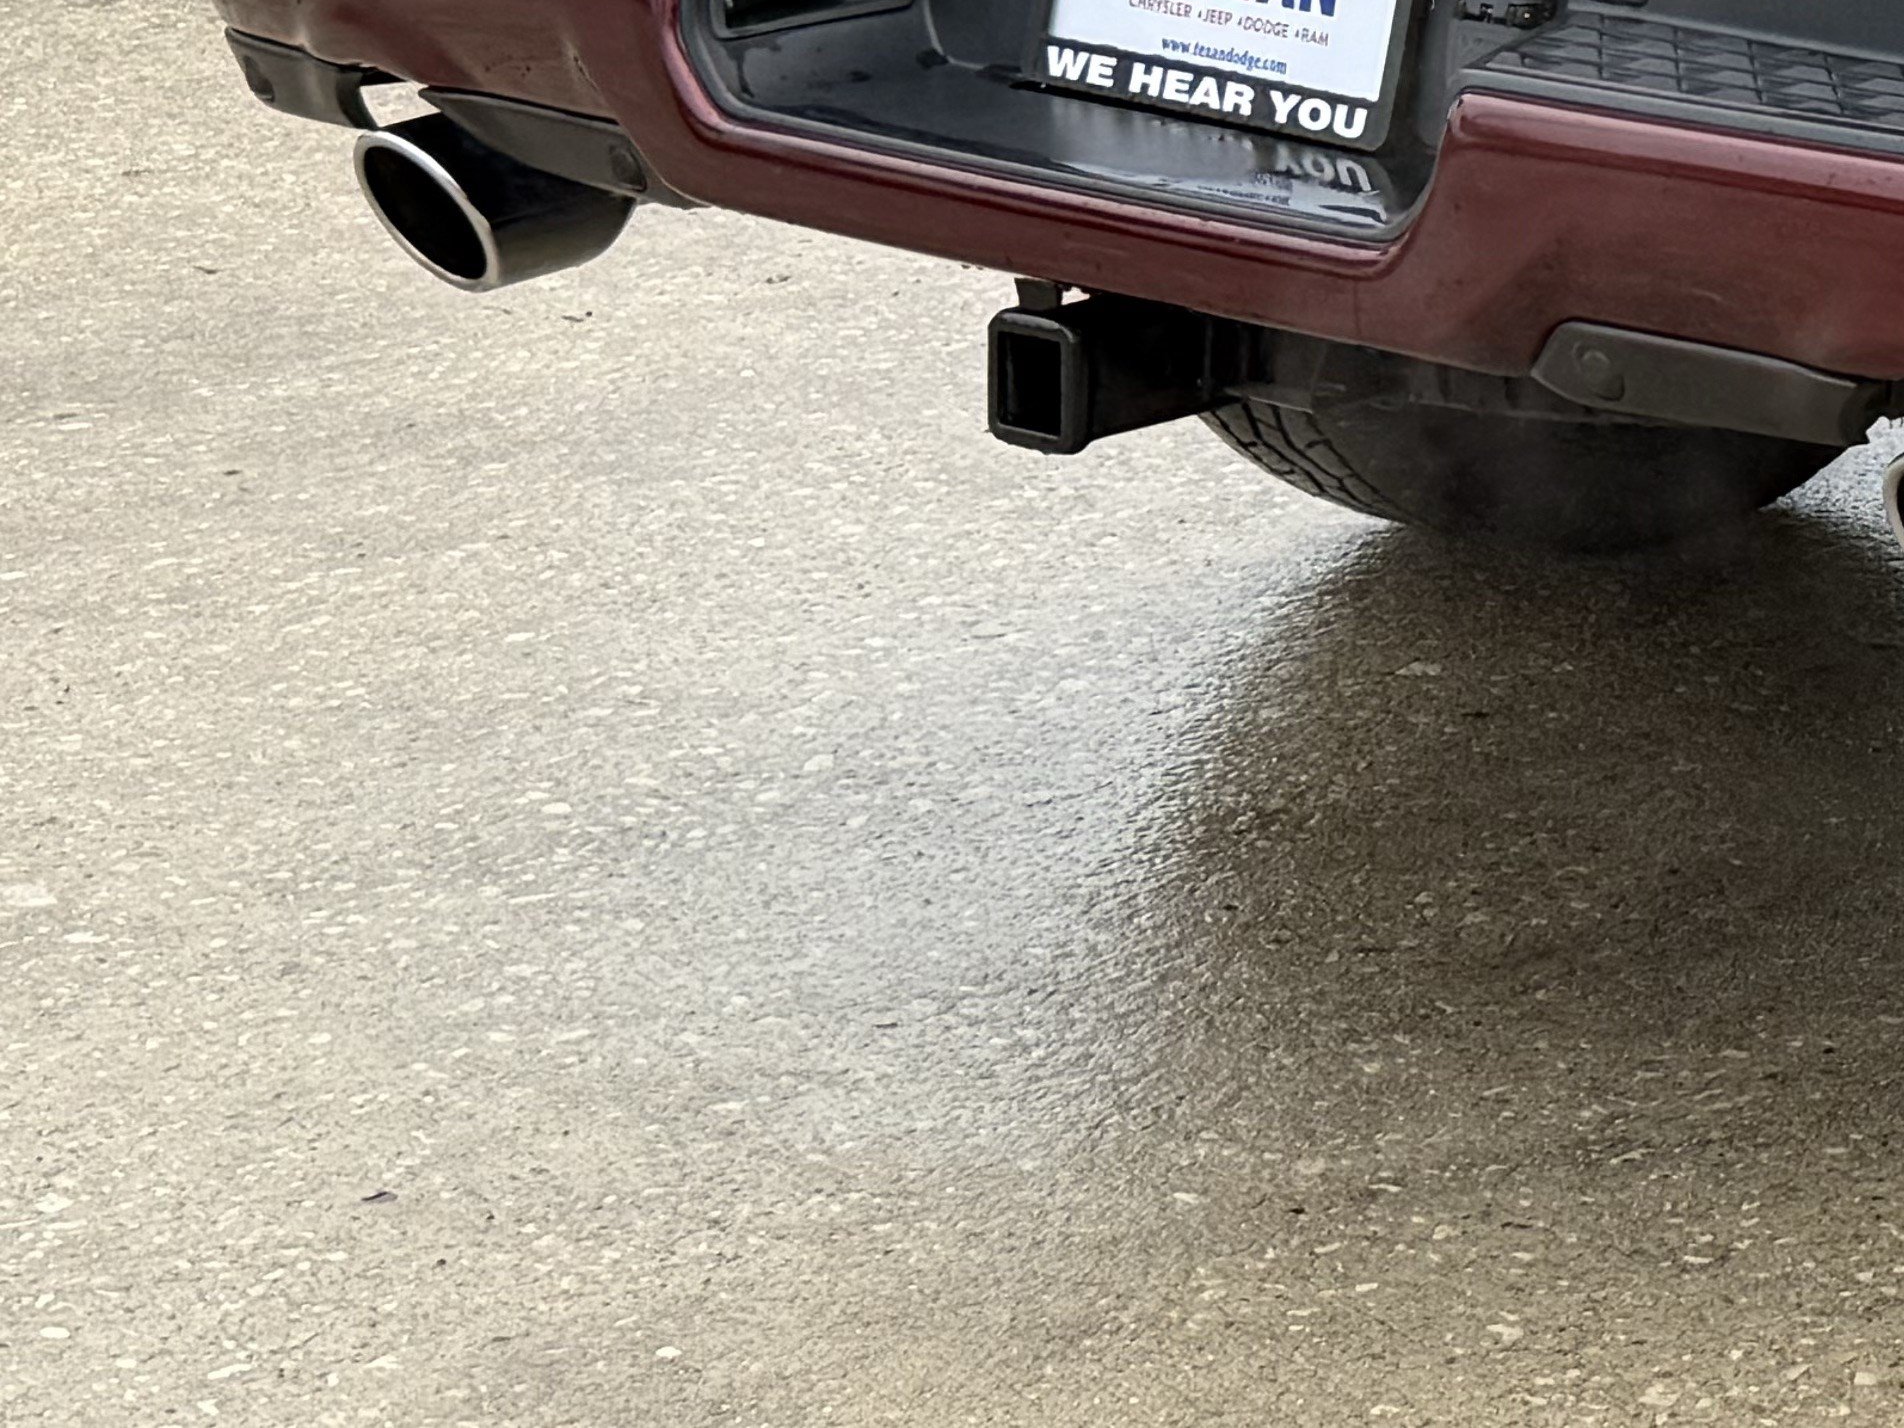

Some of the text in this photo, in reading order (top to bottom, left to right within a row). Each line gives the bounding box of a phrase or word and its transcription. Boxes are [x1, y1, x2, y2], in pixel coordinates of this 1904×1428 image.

[1046, 46, 1369, 139] WE HEAR YOU
